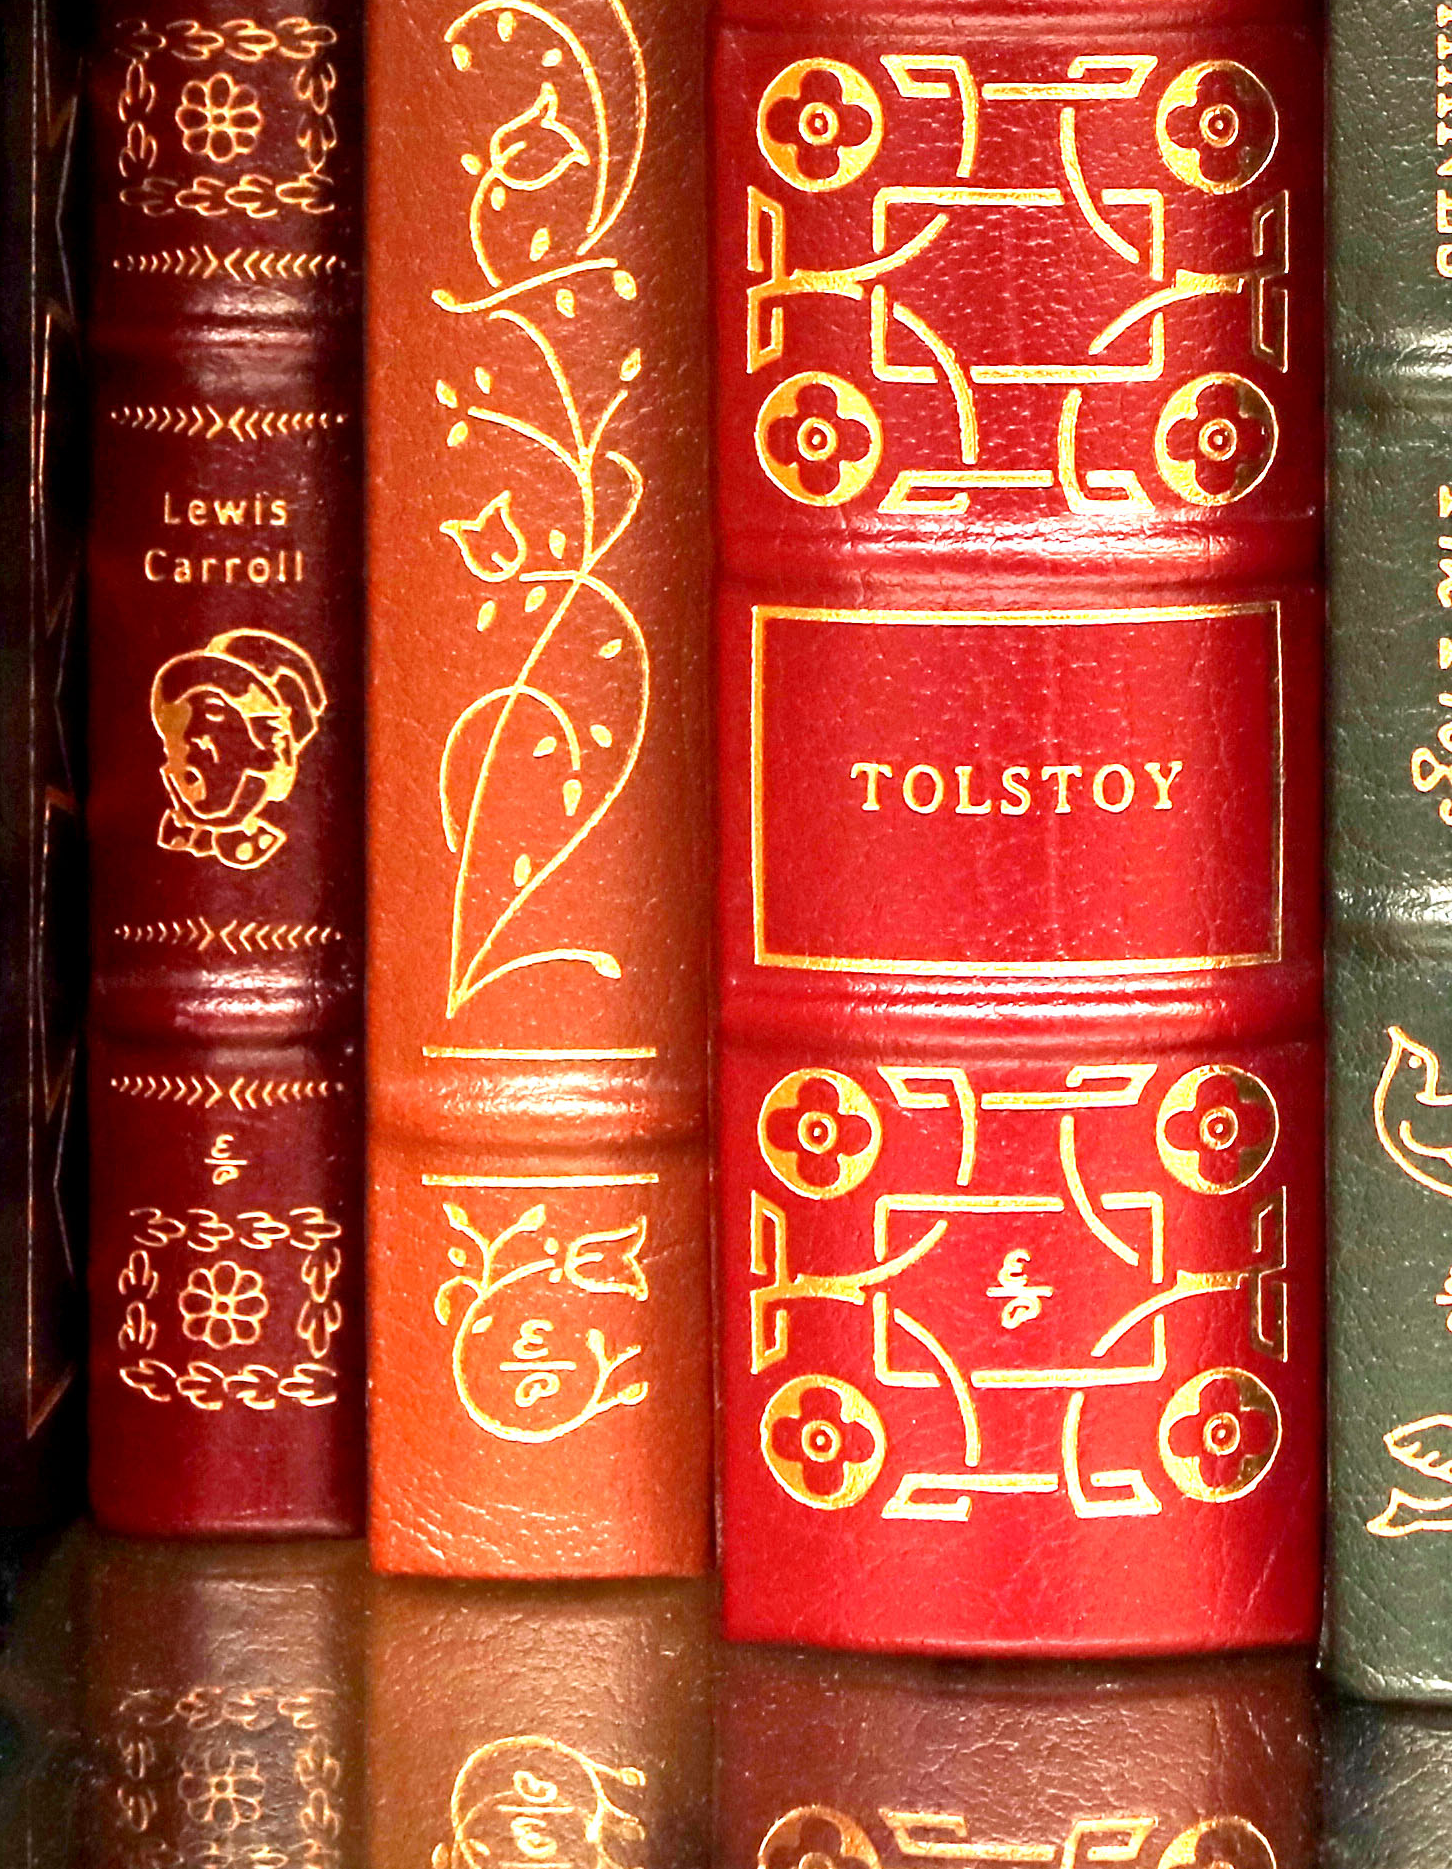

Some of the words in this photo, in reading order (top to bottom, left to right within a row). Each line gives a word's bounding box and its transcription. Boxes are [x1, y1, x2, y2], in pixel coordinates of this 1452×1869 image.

[162, 490, 289, 529] Lewis
[142, 547, 305, 586] Carroll
[848, 758, 1185, 818] TOLSTOY
